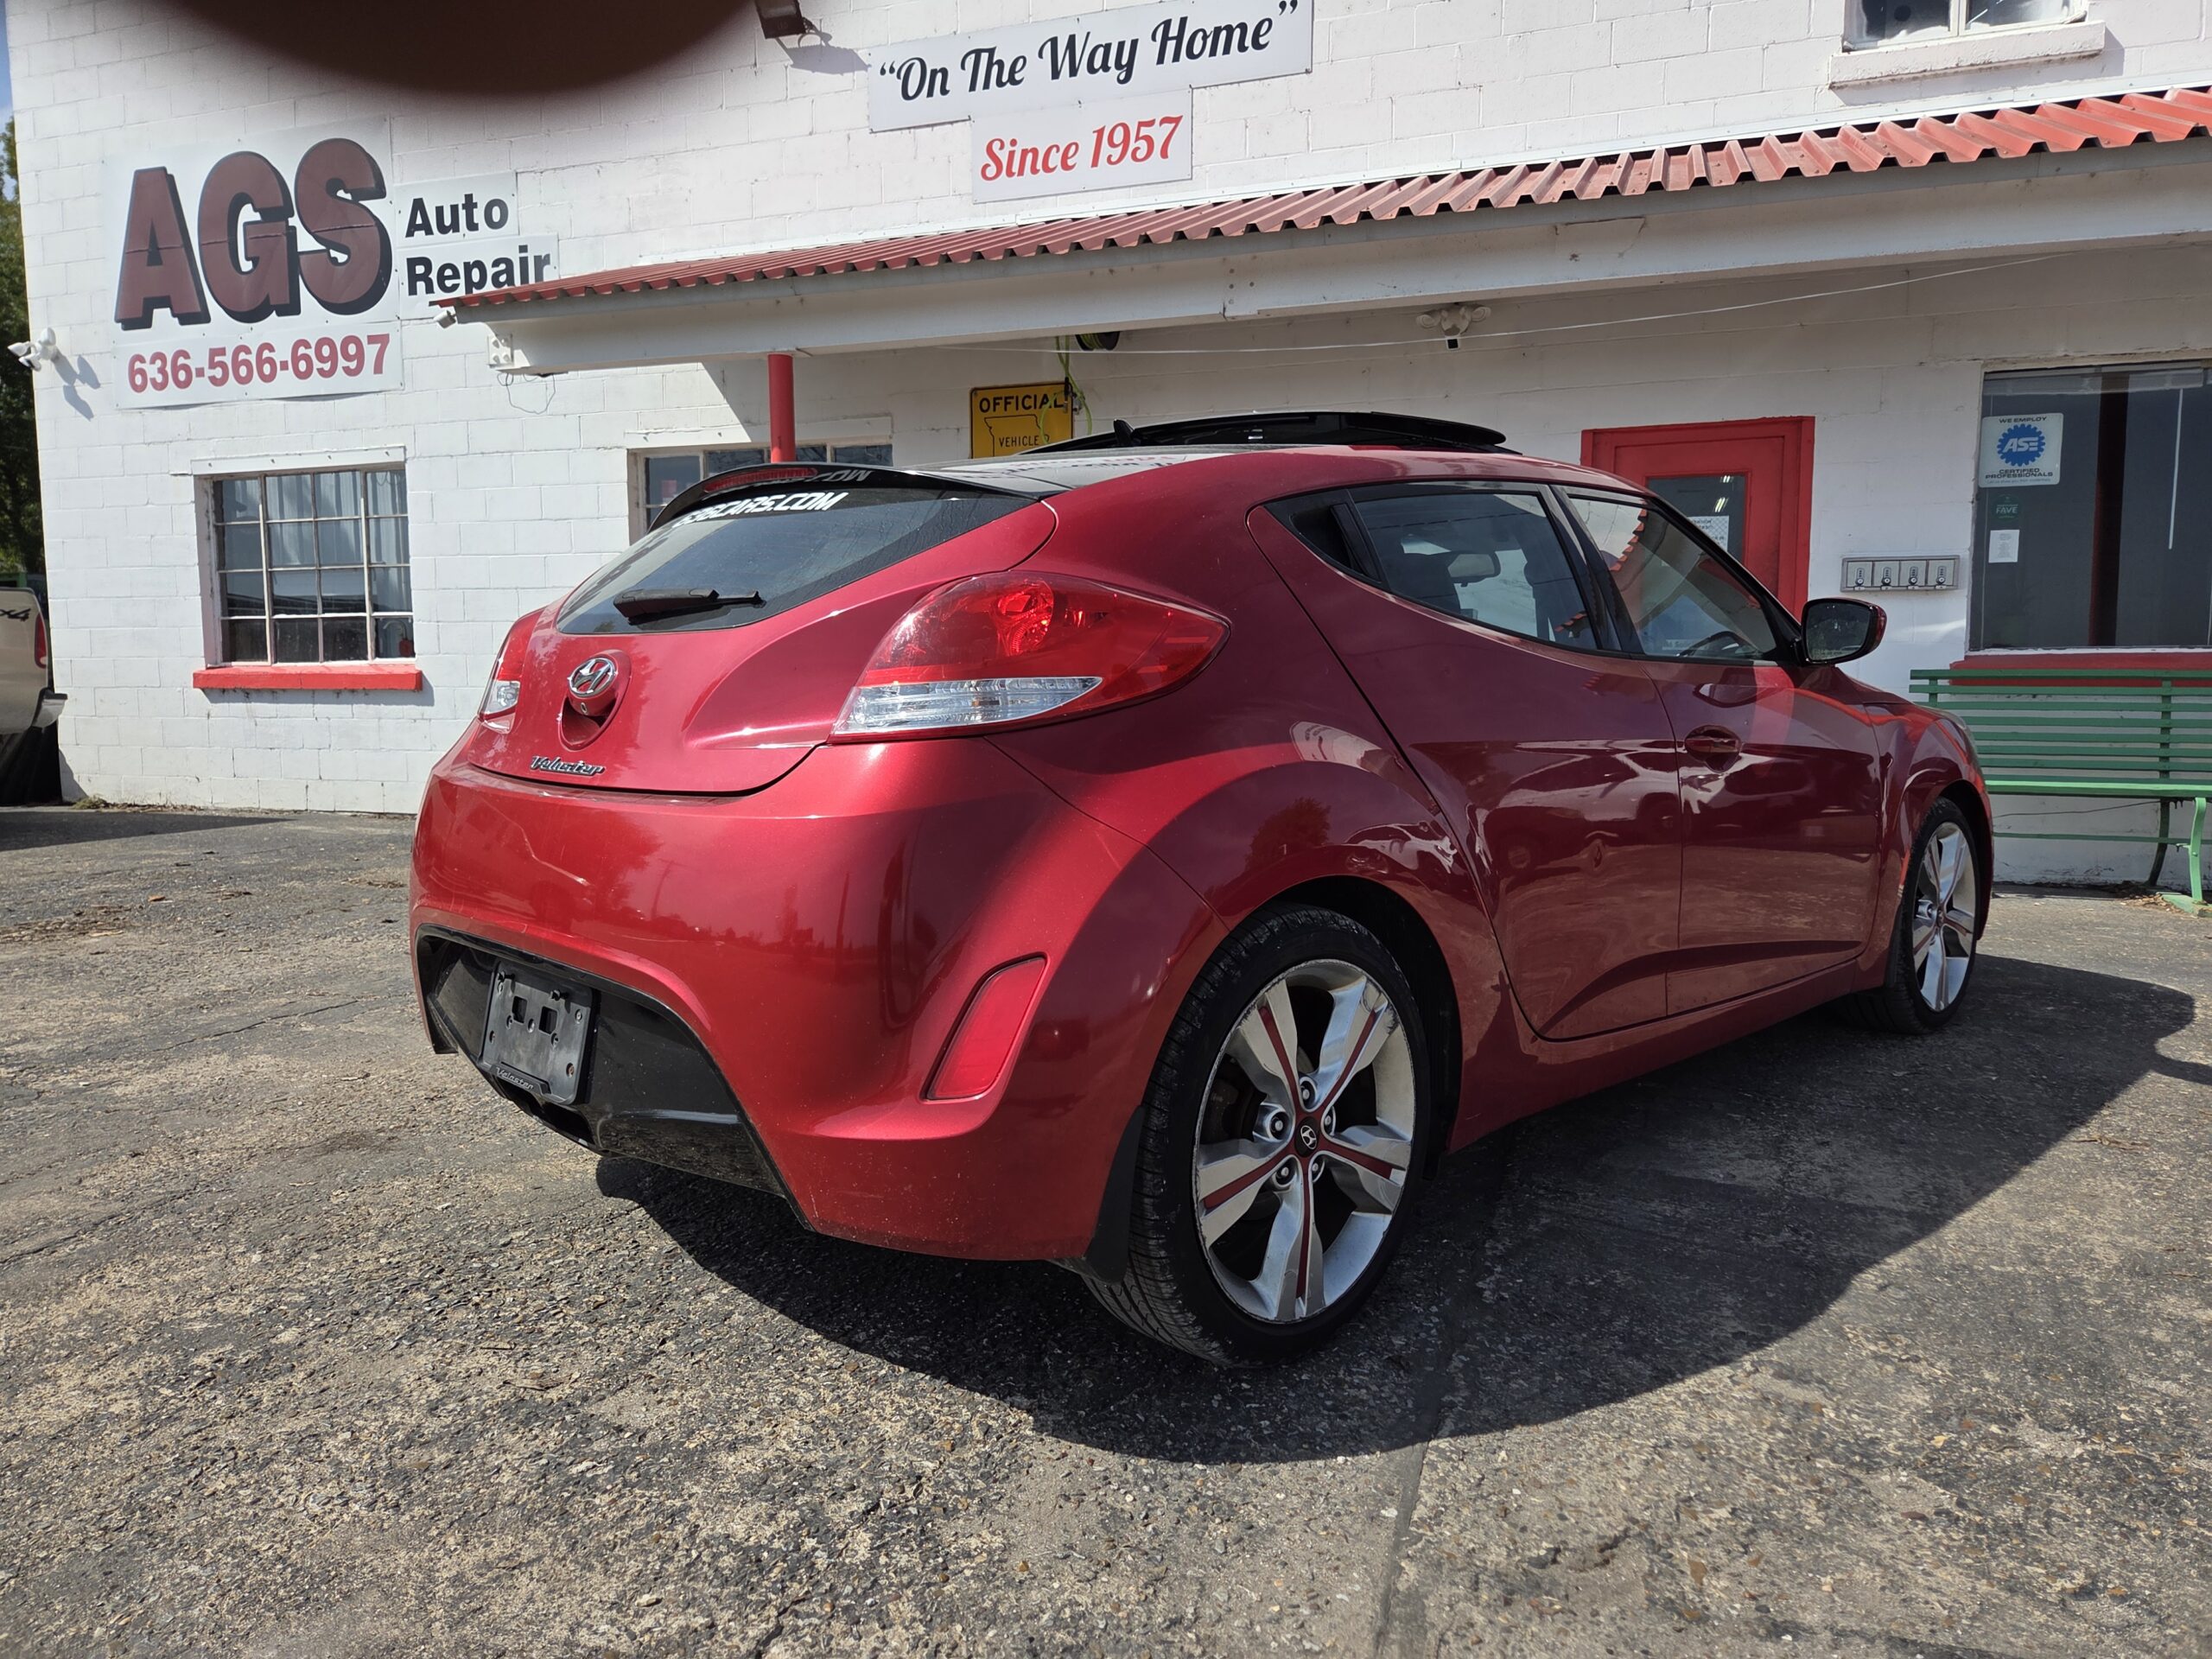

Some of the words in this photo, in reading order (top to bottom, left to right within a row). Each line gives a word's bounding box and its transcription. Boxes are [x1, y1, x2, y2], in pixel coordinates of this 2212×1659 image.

[960, 47, 1027, 92] The
[1038, 30, 1140, 85] Way
[980, 137, 1080, 181] Since
[1090, 114, 1184, 168] 1957
[115, 137, 393, 332] AGS
[404, 192, 510, 238] Auto
[406, 245, 551, 297] Repair
[128, 333, 391, 394] 636-566-6997
[979, 393, 1065, 413] OFFICIAL
[999, 435, 1039, 448] VEHICLE
[2002, 436, 2039, 453] ASE
[1996, 506, 2018, 515] FAVE
[530, 755, 605, 777] Veloster
